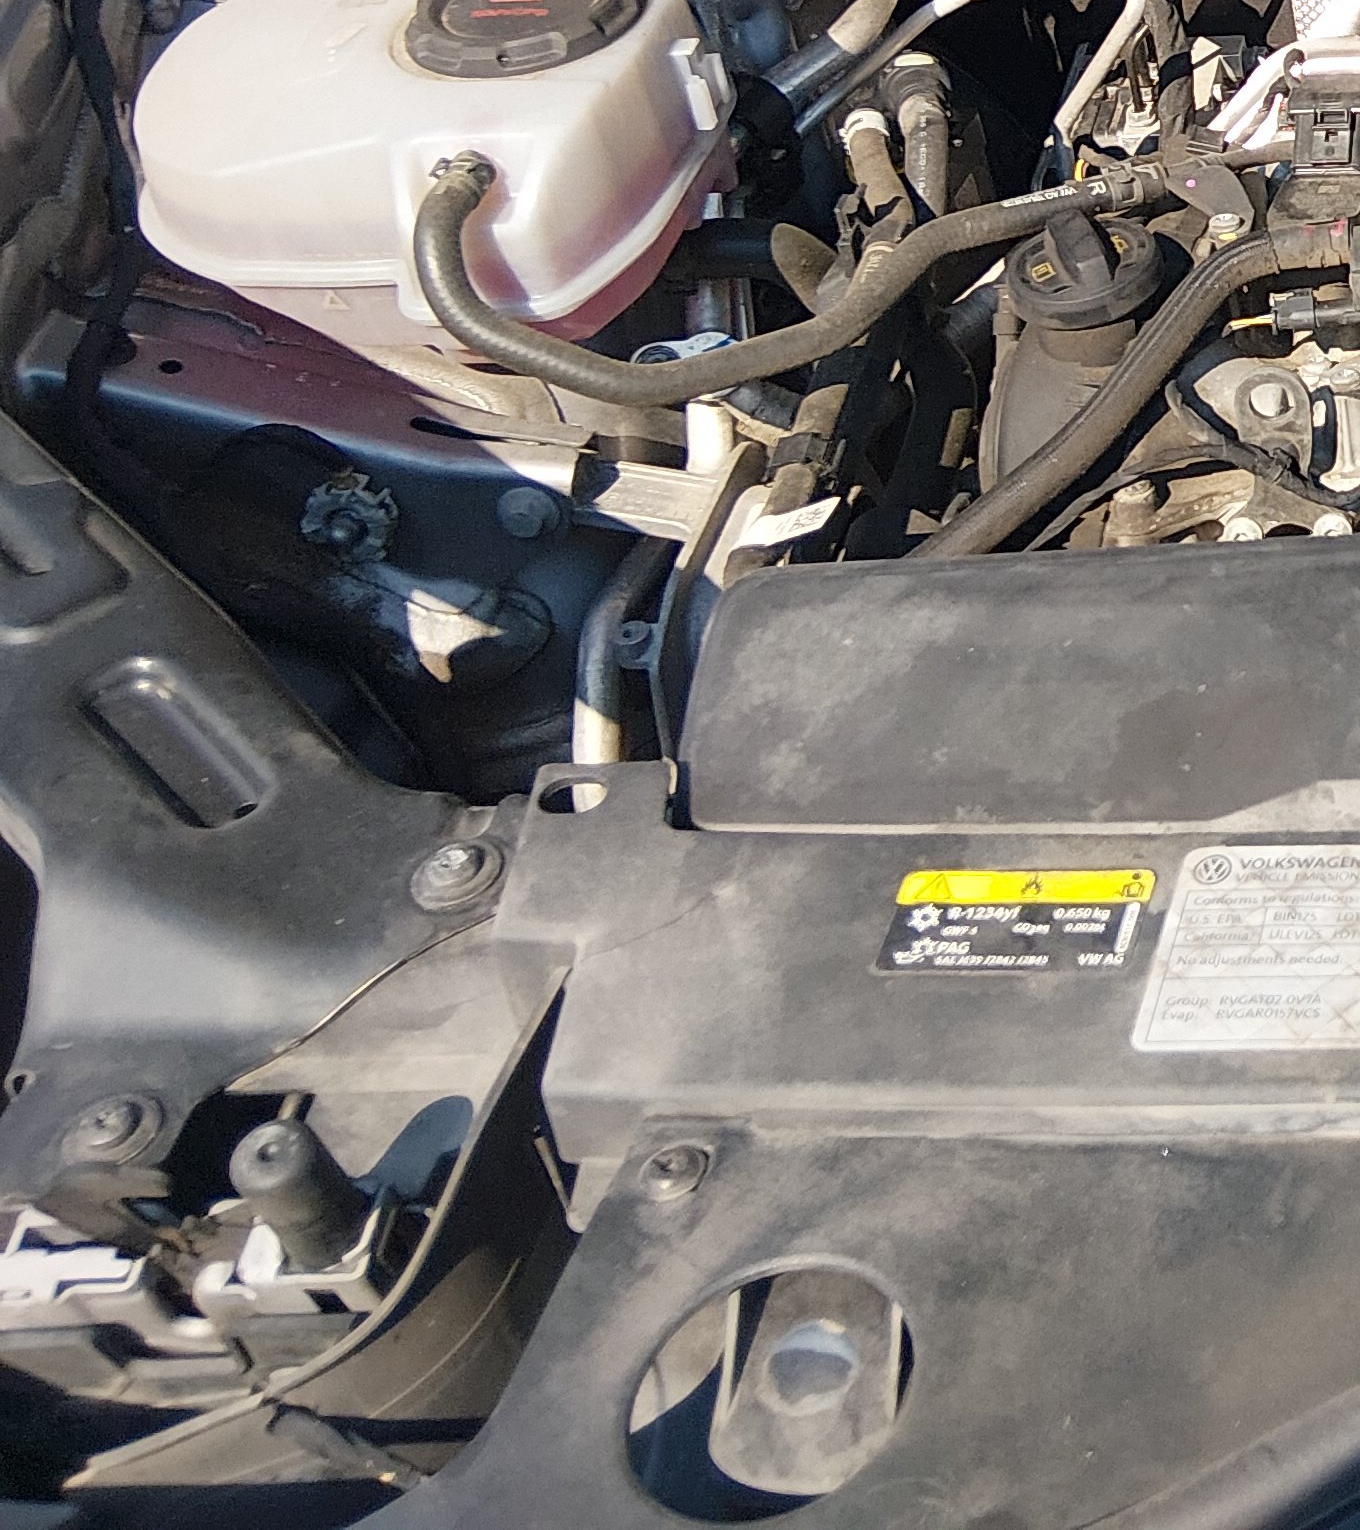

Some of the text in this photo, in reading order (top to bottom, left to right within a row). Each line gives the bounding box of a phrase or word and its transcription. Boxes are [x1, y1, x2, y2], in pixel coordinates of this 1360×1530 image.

[1236, 872, 1289, 882] VEHICLE
[1295, 871, 1359, 882] EMISSION
[947, 905, 1022, 923] R-1234yf
[1092, 906, 1111, 922] kg
[937, 940, 971, 954] PAG
[1078, 953, 1124, 966] VW AG
[1176, 954, 1343, 968] No adjustments needed.
